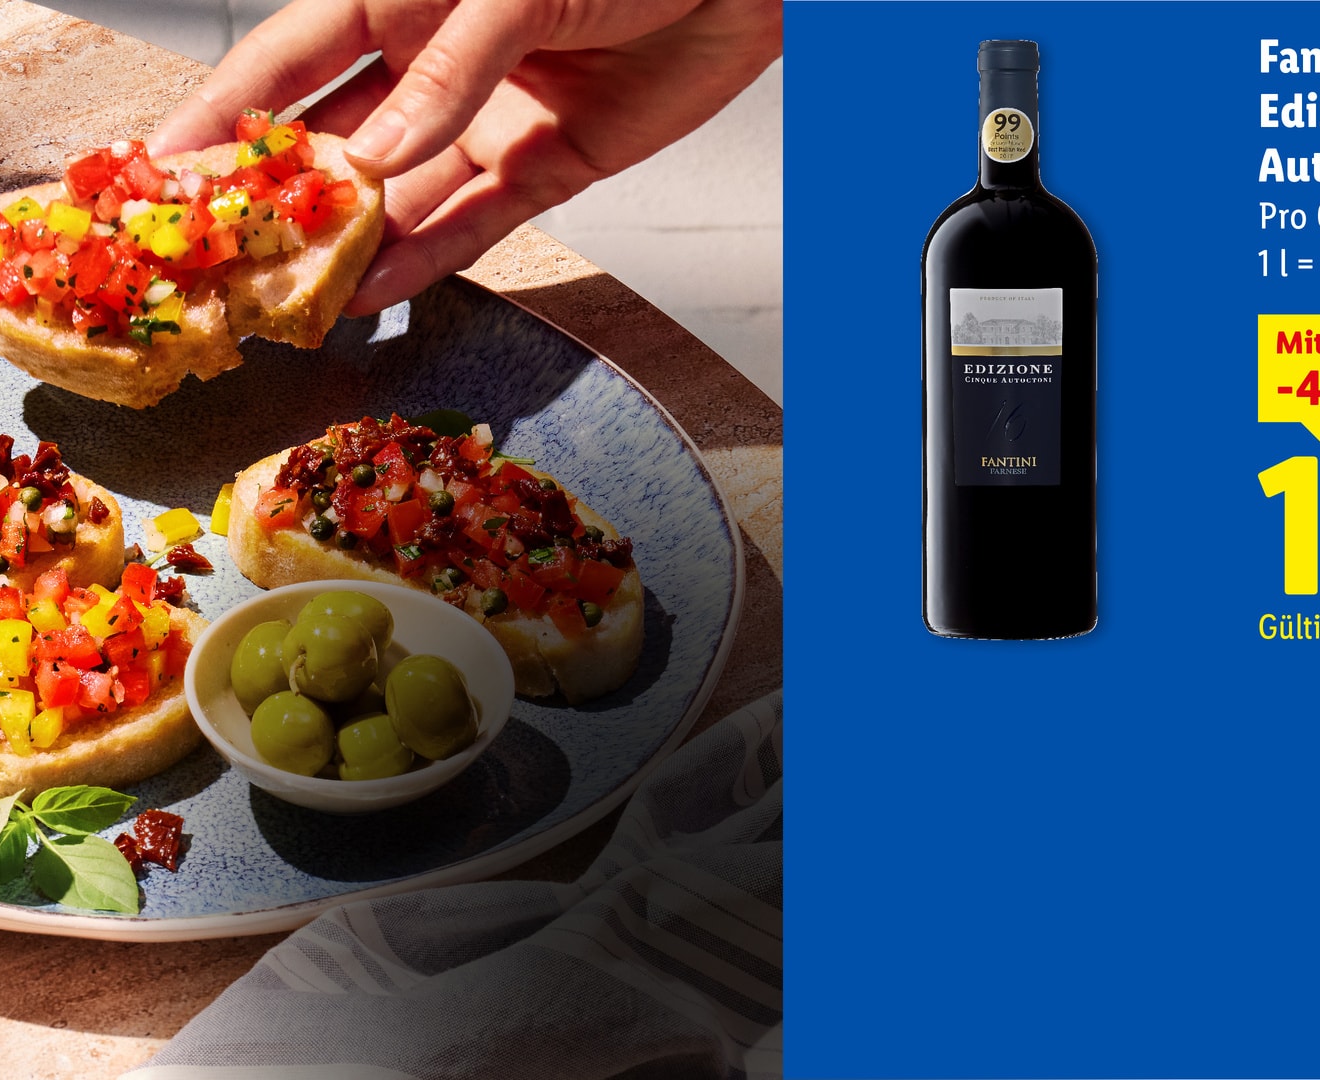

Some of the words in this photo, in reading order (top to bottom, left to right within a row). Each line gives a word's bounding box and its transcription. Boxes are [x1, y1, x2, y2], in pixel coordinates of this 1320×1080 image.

[994, 113, 1021, 132] 99
[964, 364, 1053, 374] EDIZIONE
[981, 456, 1037, 467] FANTINI
